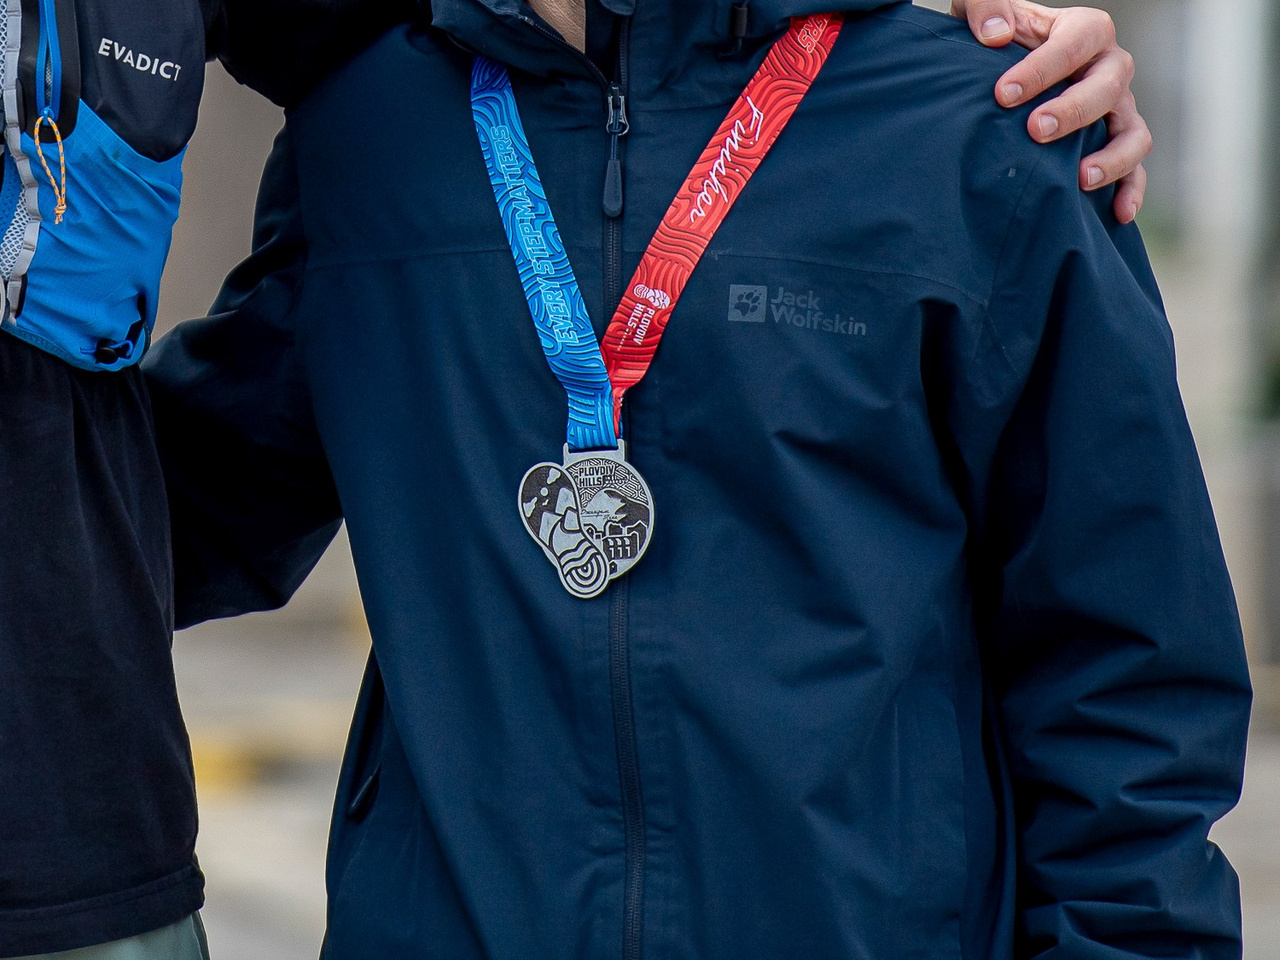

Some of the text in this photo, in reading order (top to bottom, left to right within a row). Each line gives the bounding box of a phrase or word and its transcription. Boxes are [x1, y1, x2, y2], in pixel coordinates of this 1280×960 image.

[98, 37, 182, 82] EVADICT
[690, 95, 764, 223] Finisher
[490, 124, 579, 344] EVERY STEP MATTERS
[771, 286, 821, 311] Jack
[627, 302, 646, 330] HILLS
[632, 307, 656, 346] PLOVDIV
[770, 304, 867, 337] Wolfskin
[579, 465, 615, 476] PLOVDIV
[579, 476, 602, 487] HILLS
